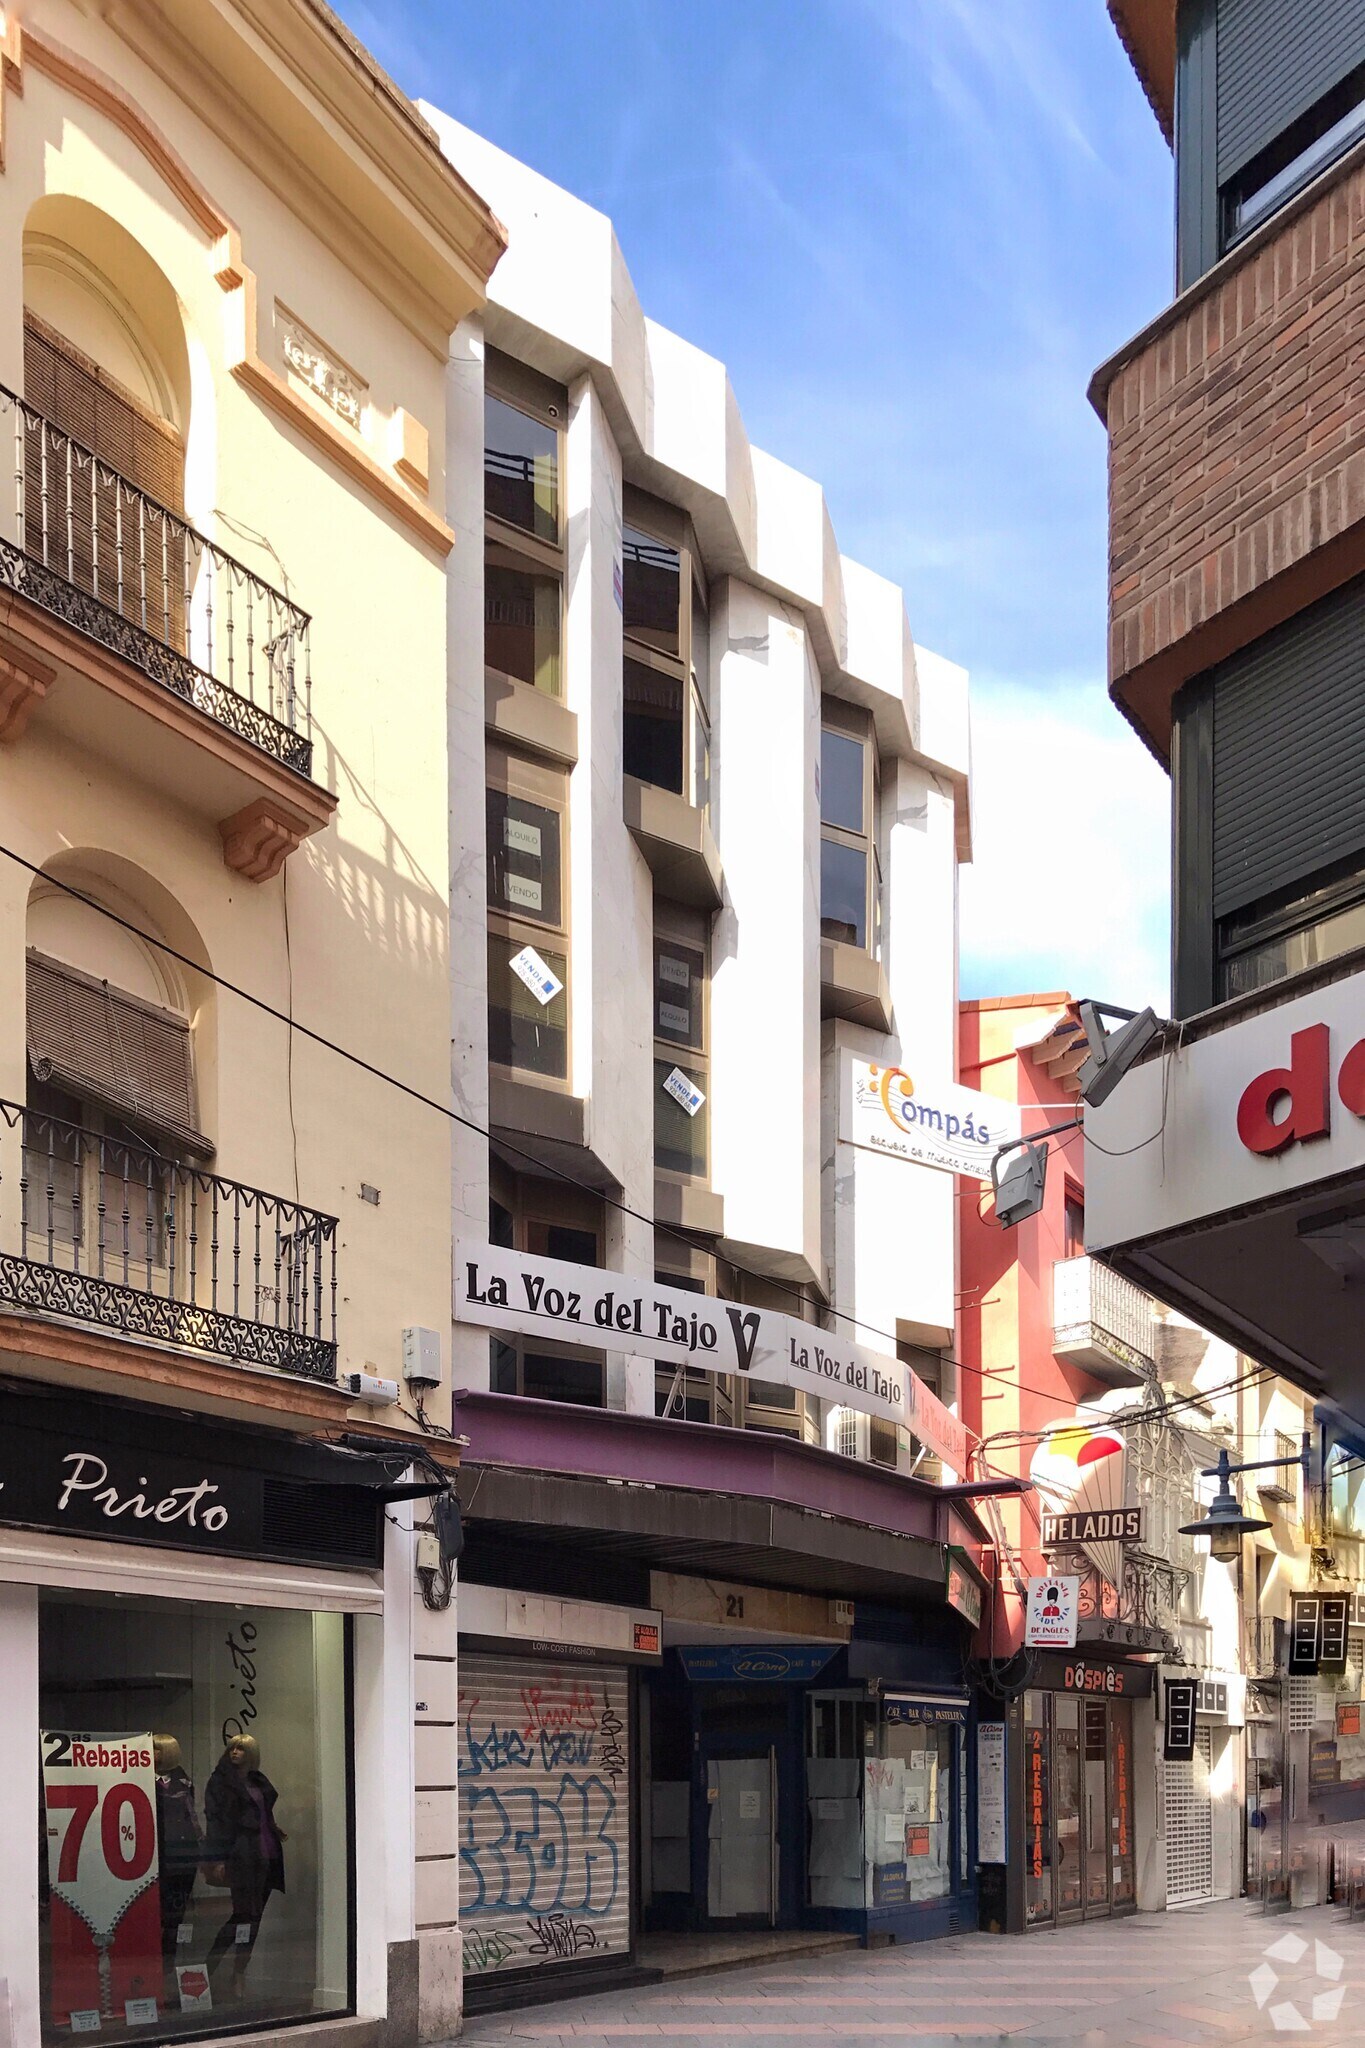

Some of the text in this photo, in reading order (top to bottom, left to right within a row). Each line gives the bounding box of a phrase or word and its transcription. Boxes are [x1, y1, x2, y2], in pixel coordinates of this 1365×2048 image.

[506, 829, 538, 844] ALQUILO
[508, 885, 538, 900] VENDO
[520, 954, 543, 982] VENDE
[670, 1075, 691, 1098] VENDE
[466, 1261, 718, 1352] La Voz del Tajo
[790, 1337, 902, 1404] La Voz del Tajo
[57, 1452, 229, 1532] Prieto
[1045, 1511, 1139, 1542] HELADOS
[726, 1594, 744, 1618] 21
[550, 1644, 568, 1653] COST
[569, 1646, 596, 1656] FASHION
[222, 1621, 257, 1746] Prieto
[908, 1708, 920, 1719] BAR
[72, 1743, 151, 1774] Rebajas
[1032, 1731, 1043, 1879] 2 REBAJAS
[1118, 1743, 1128, 1856] REBAJAS
[45, 1782, 156, 1884] 70
